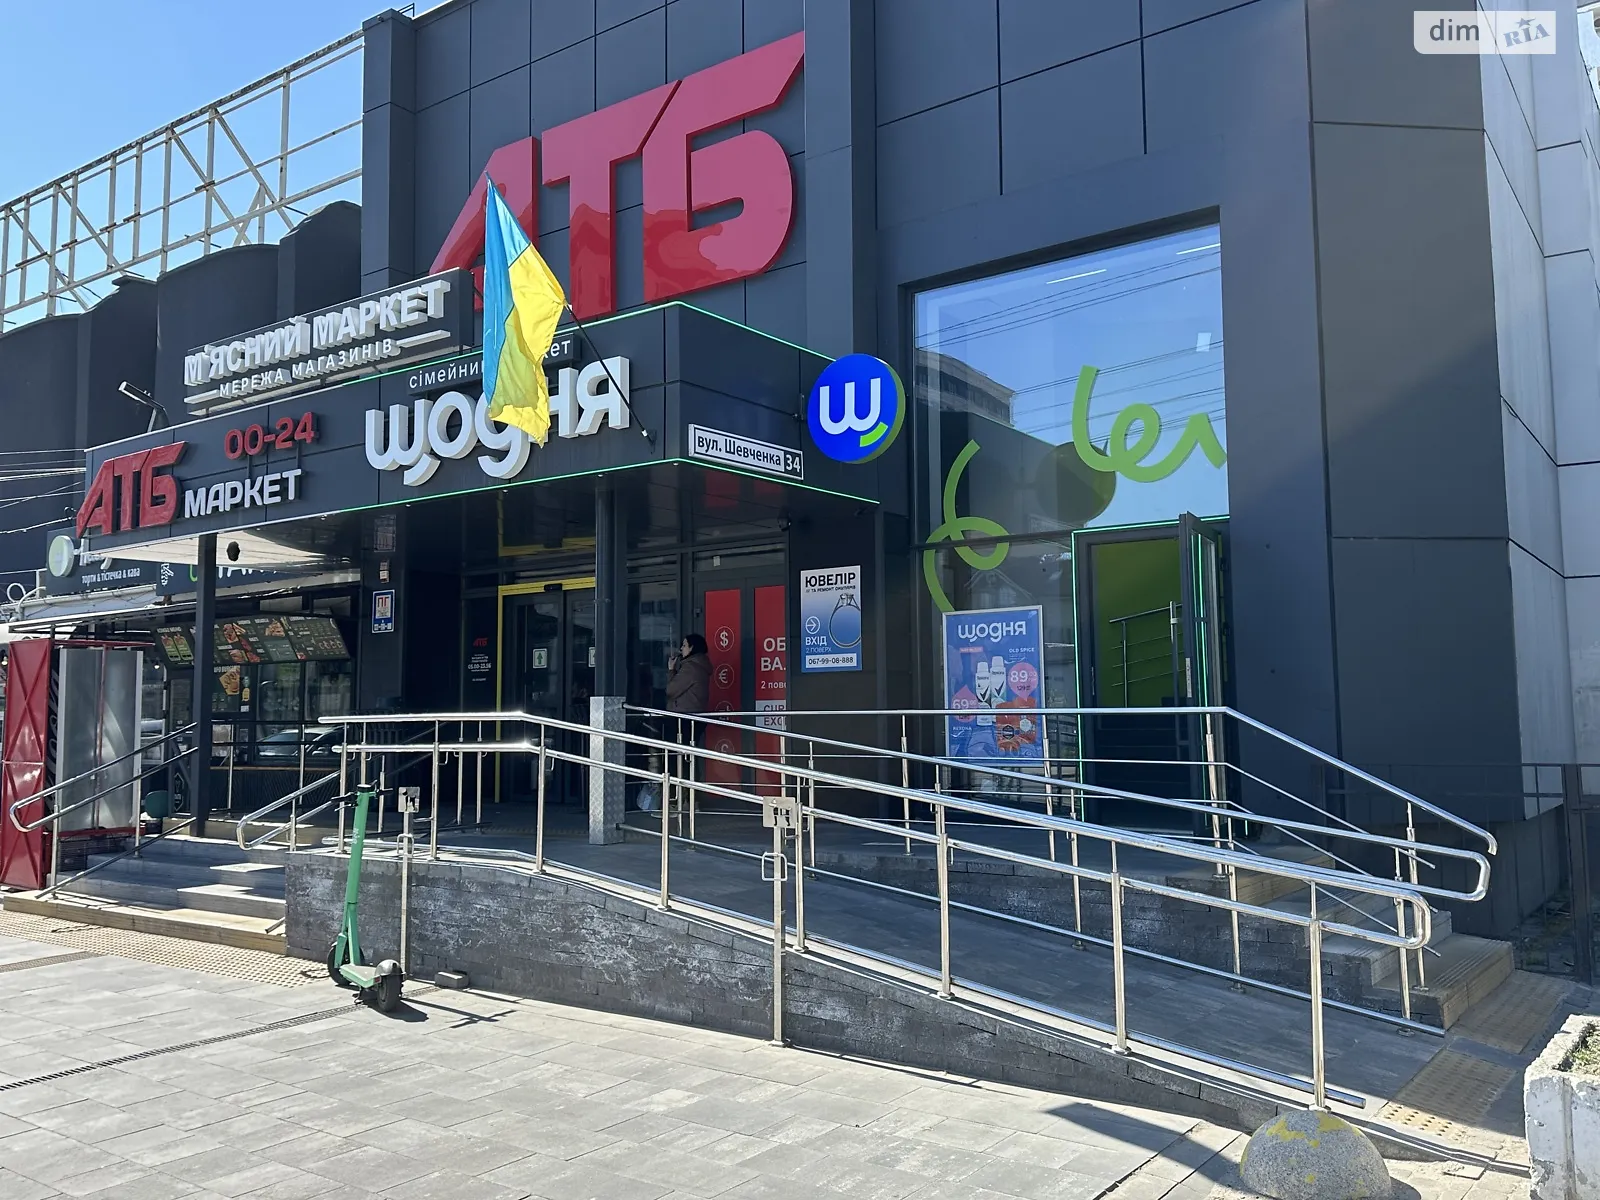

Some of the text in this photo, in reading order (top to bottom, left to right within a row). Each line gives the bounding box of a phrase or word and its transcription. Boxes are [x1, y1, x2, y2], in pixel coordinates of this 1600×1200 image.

[429, 30, 806, 322] АТБ
[312, 279, 450, 350] МАРКЕТ
[219, 338, 400, 399] МЕРЕЖА МАГАЗИНІВ
[409, 360, 484, 390] сімейни
[224, 411, 317, 461] 00-24
[697, 434, 801, 473] вул. Шевченка 34
[76, 441, 302, 539] АТБ МАРКЕТ
[805, 572, 856, 588] ЮВЕЛІР
[805, 636, 828, 647] ВХІД
[761, 656, 786, 672] ВА
[1010, 670, 1028, 683] 89
[761, 680, 766, 689] 2
